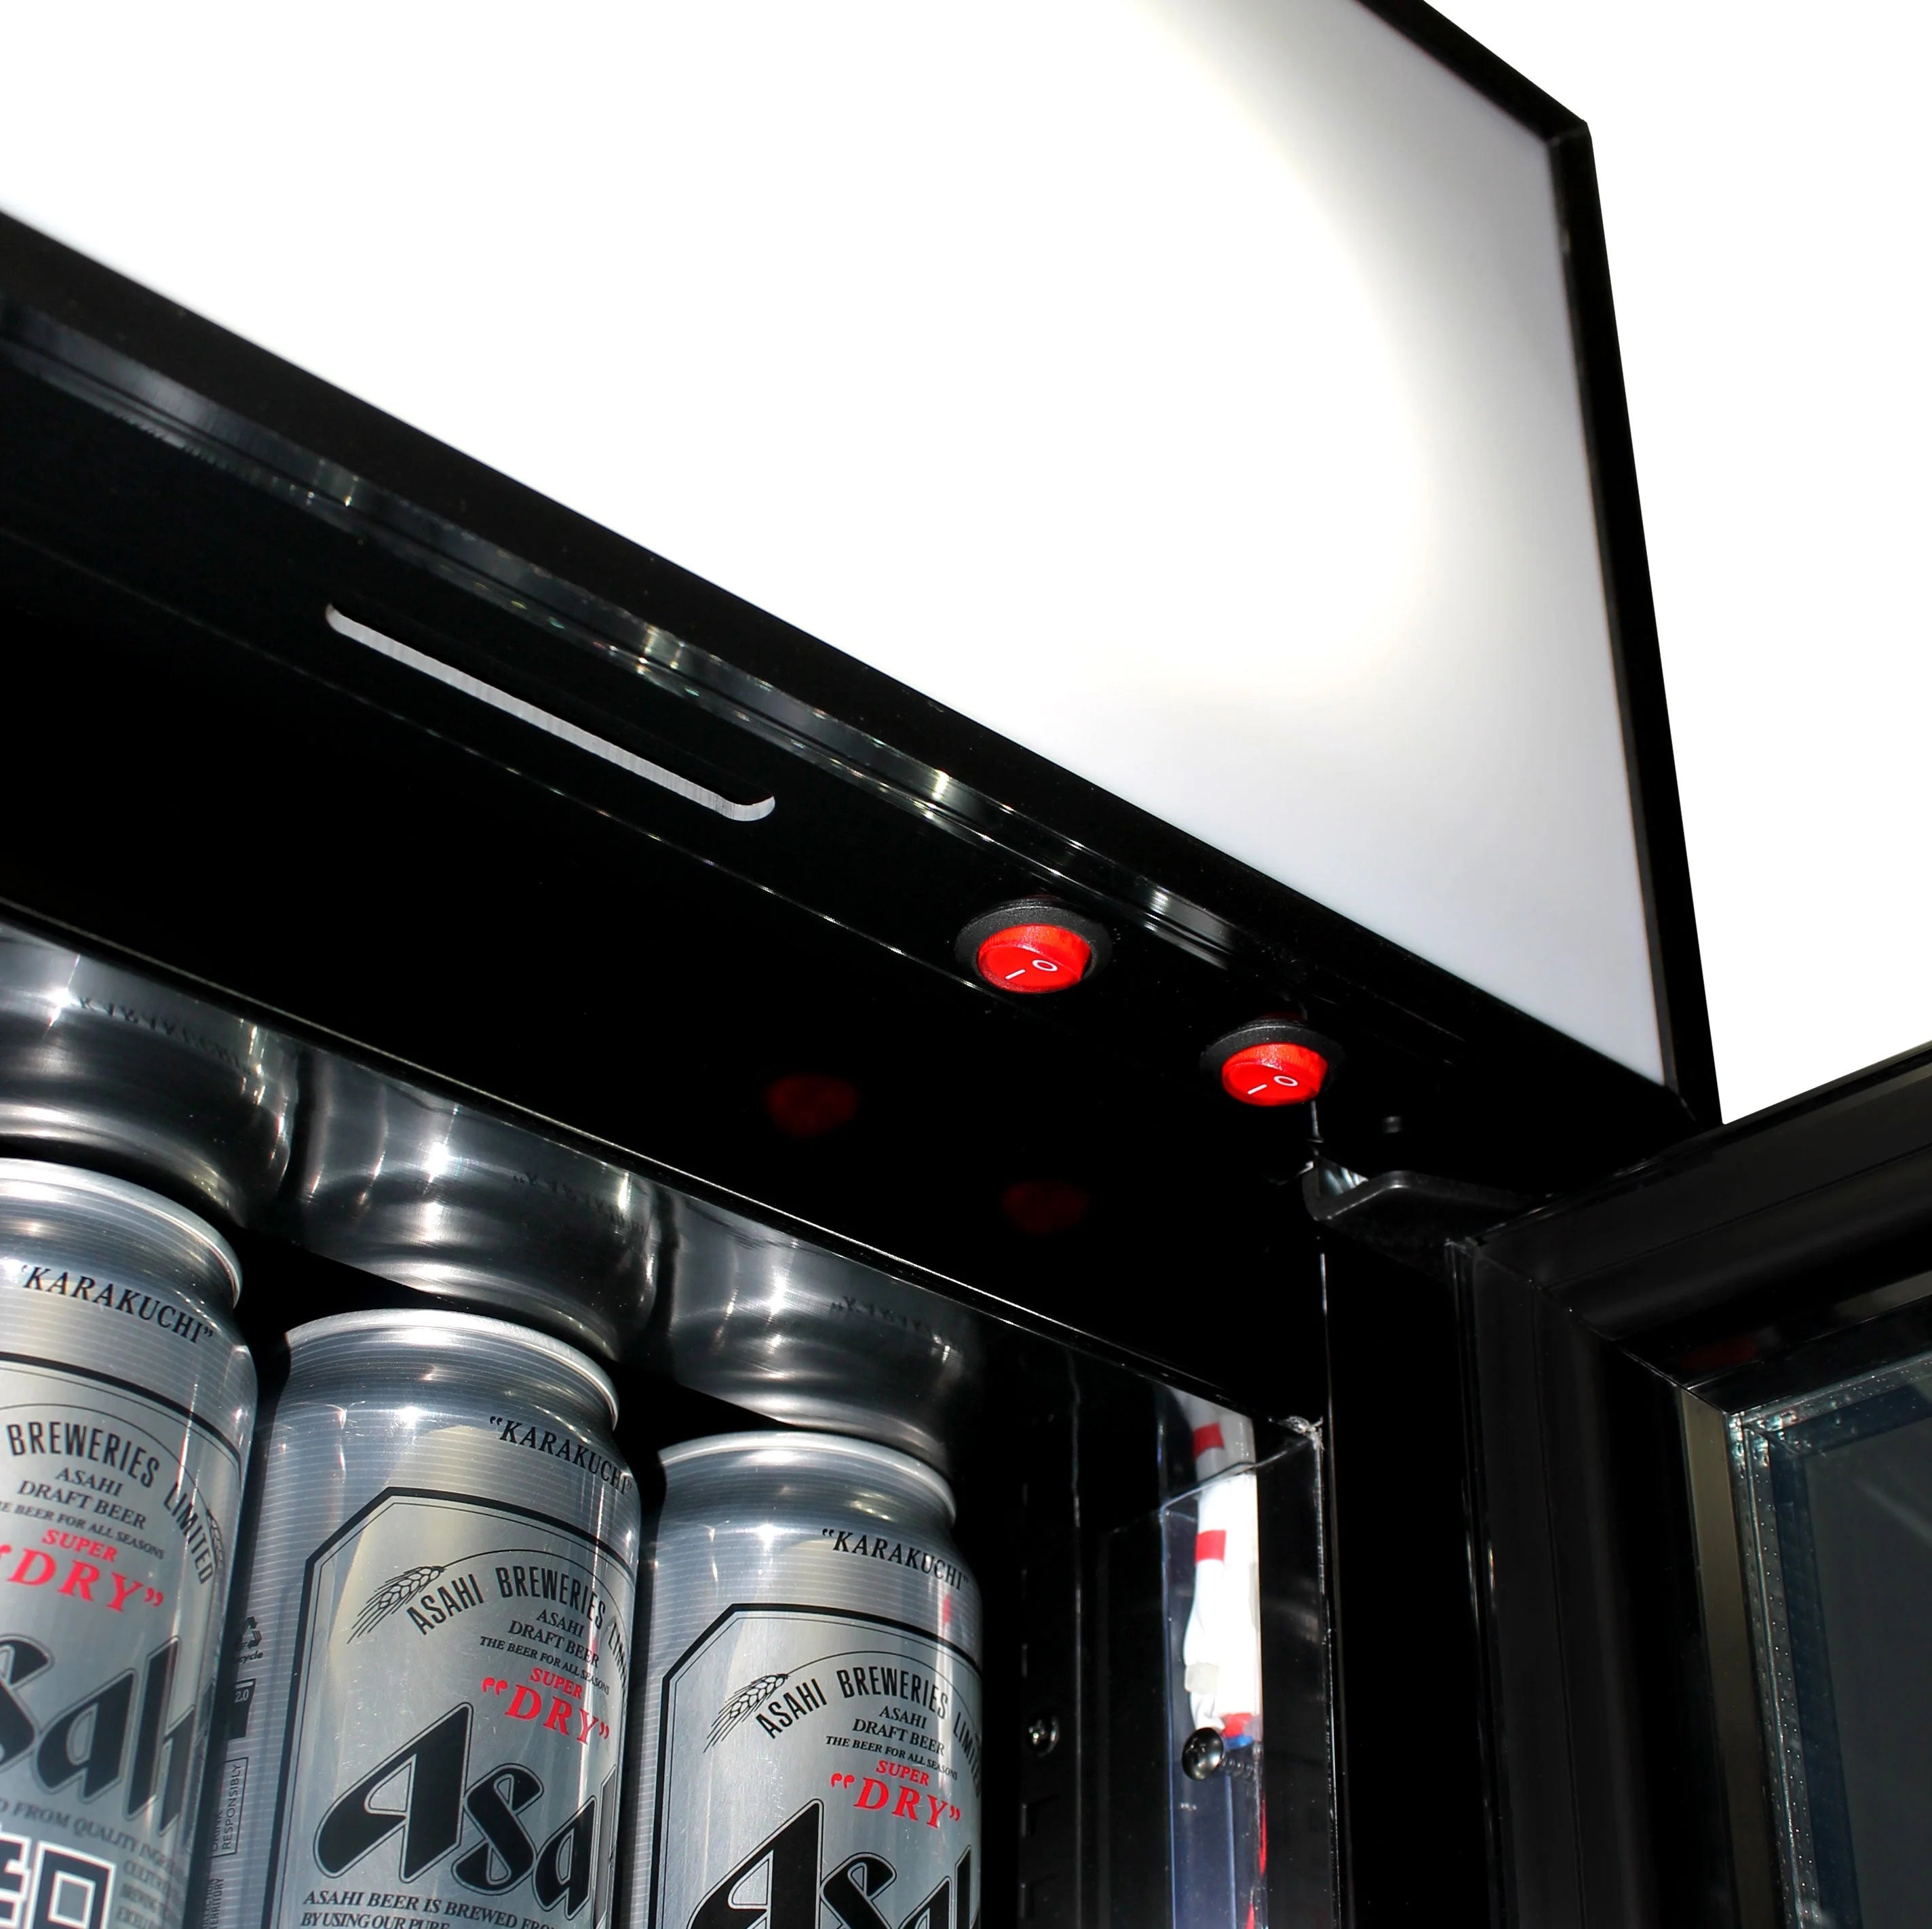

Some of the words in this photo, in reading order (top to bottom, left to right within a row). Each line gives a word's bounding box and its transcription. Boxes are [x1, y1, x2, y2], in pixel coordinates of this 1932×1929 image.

[489, 1416, 632, 1495] “KARAKUCHI”
[7, 1421, 160, 1489] BREWERIES
[163, 1481, 216, 1585] LIMITED
[16, 1480, 93, 1510] DRAFT
[92, 1500, 148, 1530] BEER
[55, 1467, 125, 1498] ASAHI
[41, 1528, 119, 1563] SUPER
[57, 1510, 89, 1531] FOR
[88, 1521, 115, 1539] ALL
[115, 1531, 166, 1560] SEASONS
[822, 1527, 970, 1591] “KARAKUCHI”
[406, 1573, 484, 1636] ASAHI
[495, 1565, 606, 1630] BREWERIES
[536, 1609, 585, 1638] ASAHI
[480, 1635, 505, 1650] THE
[506, 1643, 539, 1658] BEER
[539, 1652, 563, 1668] FOR
[562, 1662, 580, 1677] ALL
[581, 1670, 611, 1696] SEASONS
[507, 1620, 564, 1649] DRAFT
[564, 1639, 600, 1669] BEER
[528, 1667, 583, 1700] SUPER
[755, 1678, 828, 1740] ASAHI
[836, 1666, 949, 1720] BREWERIES
[481, 1676, 610, 1745] “DRY”
[878, 1705, 928, 1730] ASAHI
[825, 1736, 851, 1747] THE
[851, 1740, 883, 1753] BEER
[884, 1746, 907, 1759] FOR
[908, 1753, 926, 1766] ALL
[926, 1758, 959, 1780] SEASONS
[851, 1718, 909, 1742] DRAFT
[909, 1732, 945, 1756] BEER
[875, 1759, 930, 1787] SUPER
[221, 1764, 242, 1850] RESPONSIBLY
[830, 1772, 961, 1829] “DRY”
[14, 1801, 71, 1828] FROM
[73, 1817, 138, 1854] QUALITY
[300, 1911, 323, 1928] BY
[322, 1912, 371, 1929] USING
[370, 1914, 407, 1929] OUR
[303, 1890, 364, 1906] ASAHI
[366, 1892, 420, 1911] BEER
[422, 1898, 442, 1913] IS
[444, 1901, 519, 1928] BREWED
[520, 1917, 555, 1929] FRO
